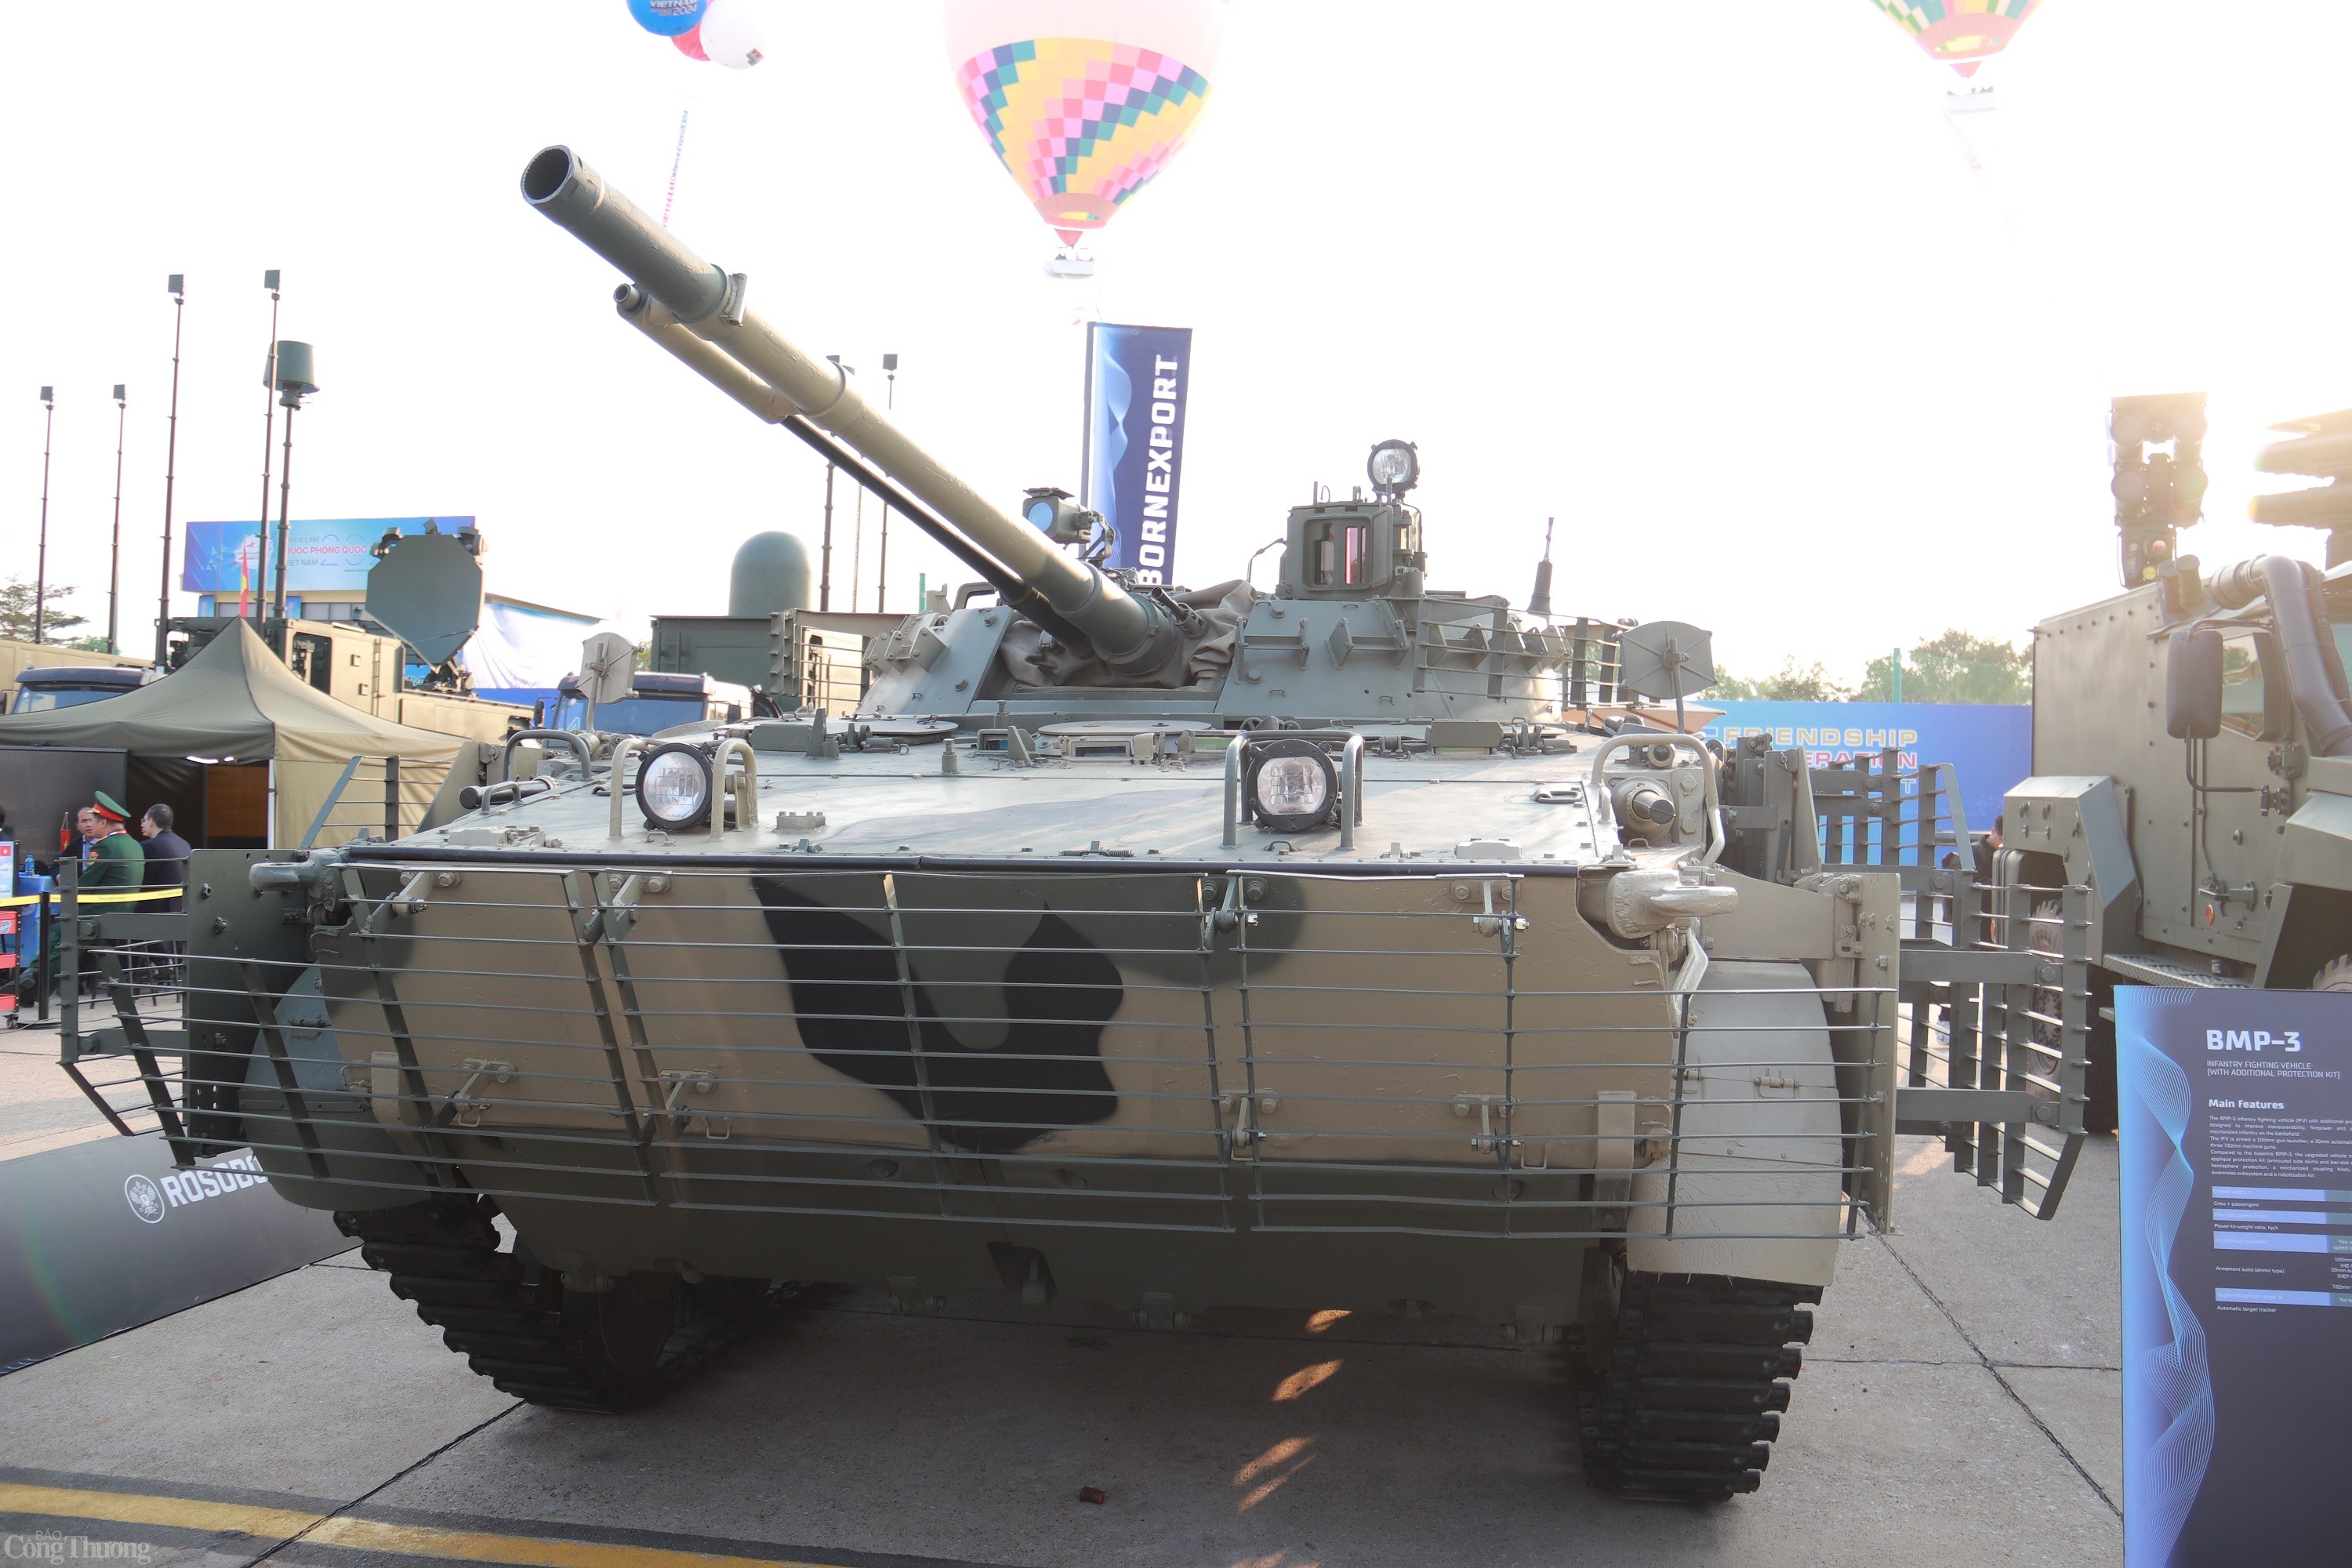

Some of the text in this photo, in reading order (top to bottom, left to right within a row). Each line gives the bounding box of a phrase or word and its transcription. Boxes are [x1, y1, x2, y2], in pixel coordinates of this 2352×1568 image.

[2206, 1029, 2301, 1052] BMP-3
[2207, 1068, 2229, 1076] (WITH
[2231, 1069, 2275, 1077] ADDITIONAL
[2325, 1071, 2340, 1080] KIT)
[2209, 1098, 2285, 1109] Main features
